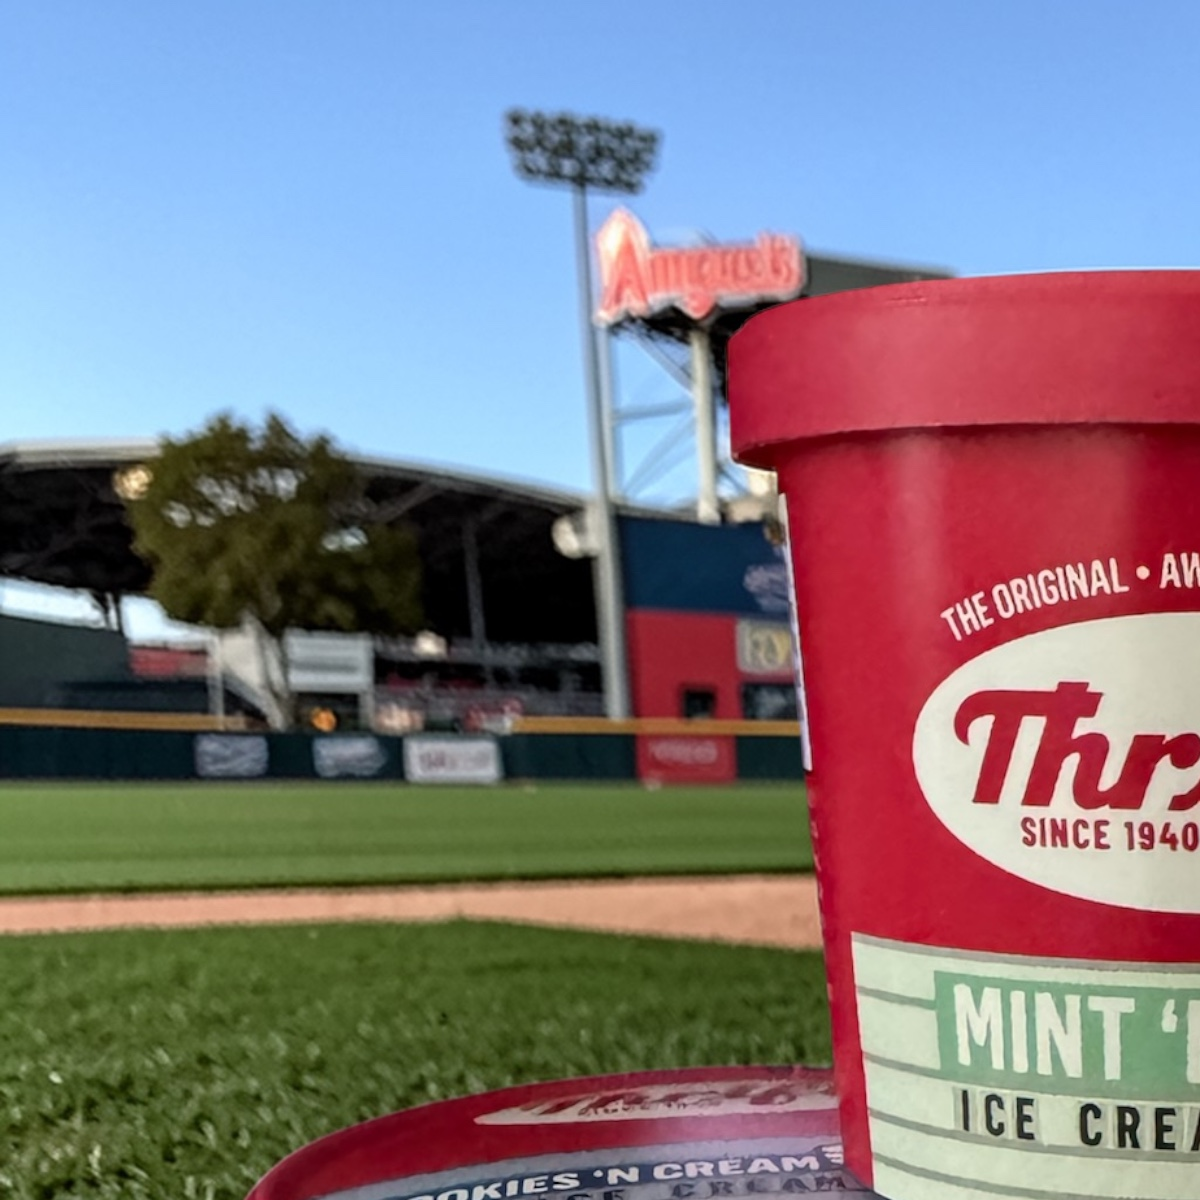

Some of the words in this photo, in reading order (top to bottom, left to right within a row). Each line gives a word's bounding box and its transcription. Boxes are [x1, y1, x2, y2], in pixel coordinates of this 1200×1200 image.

[940, 597, 994, 642] THE
[993, 557, 1130, 620] ORIGINAL
[1021, 817, 1110, 851] SINCE
[1125, 819, 1199, 852] 1940
[953, 983, 1134, 1080] MINT
[961, 1090, 1036, 1142] ICE
[653, 1154, 820, 1181] CREAM
